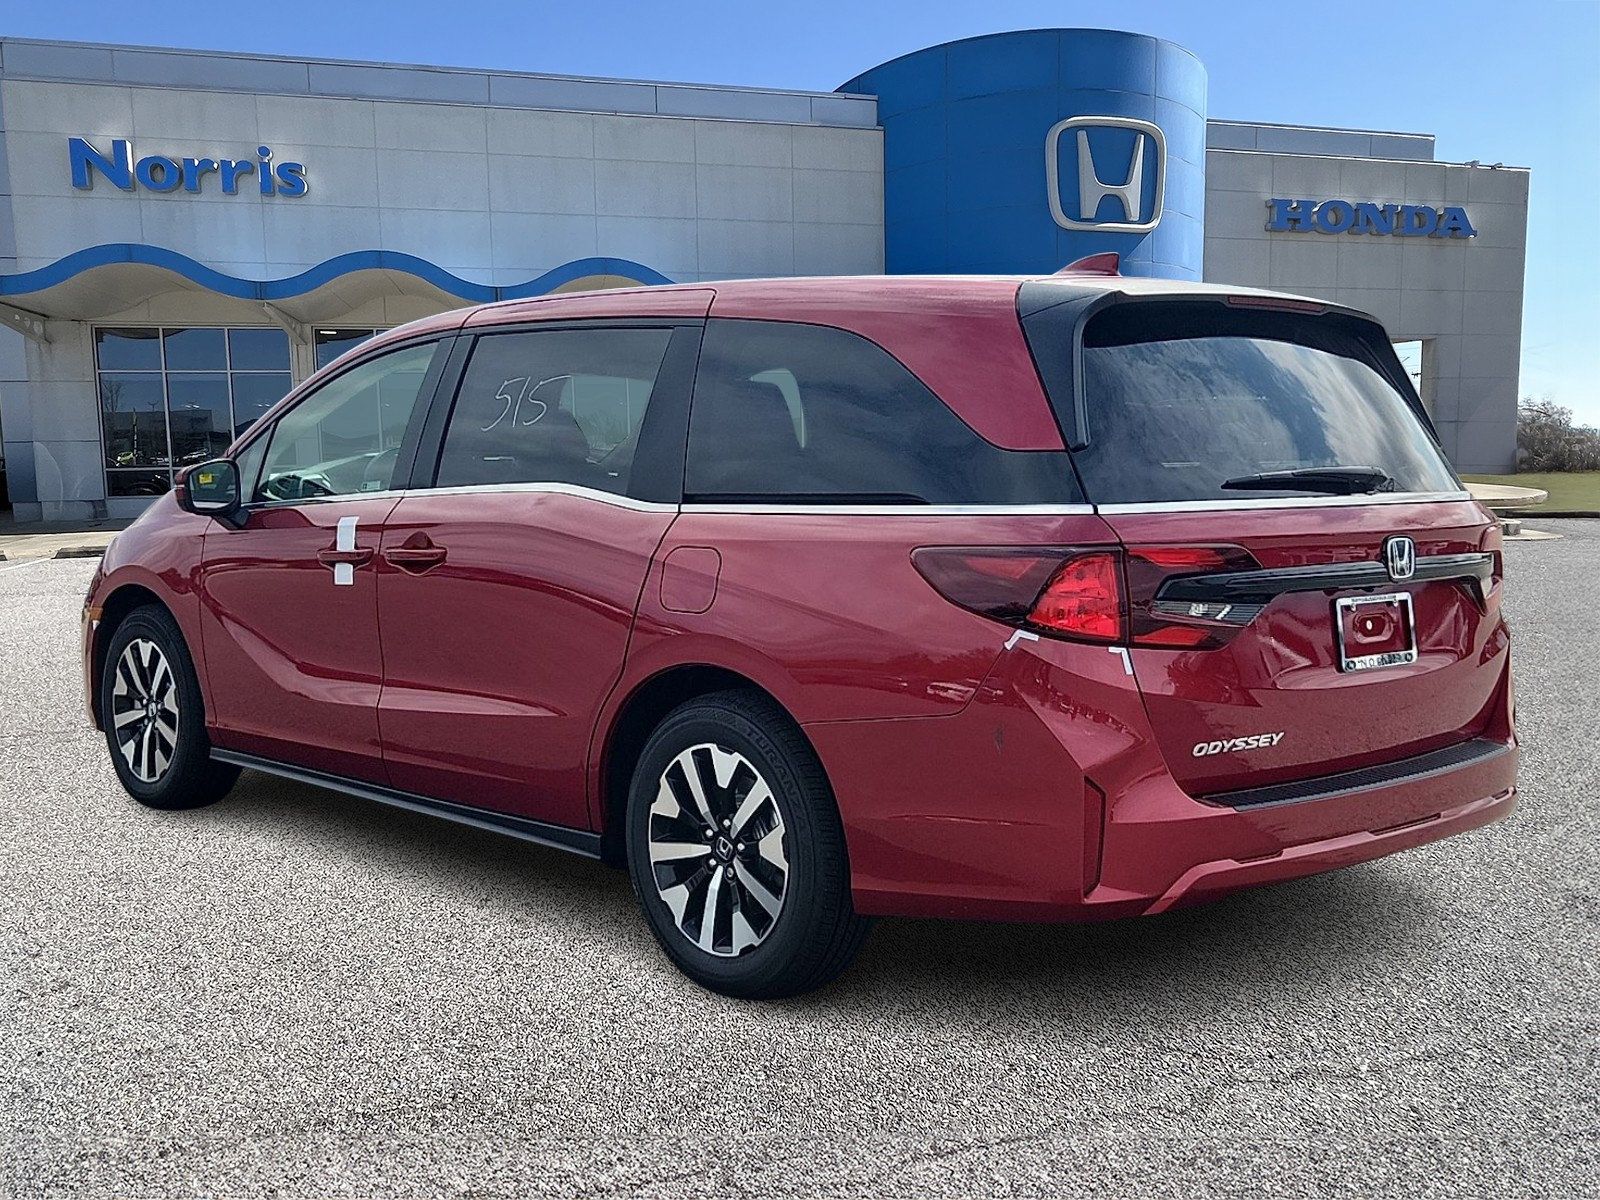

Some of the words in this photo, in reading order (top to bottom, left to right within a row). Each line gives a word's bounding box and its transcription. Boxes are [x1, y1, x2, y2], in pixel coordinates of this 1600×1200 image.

[67, 137, 309, 197] Norris
[1266, 198, 1478, 239] HONDA
[480, 374, 573, 432] 515
[1192, 731, 1285, 757] ODYSSEY
